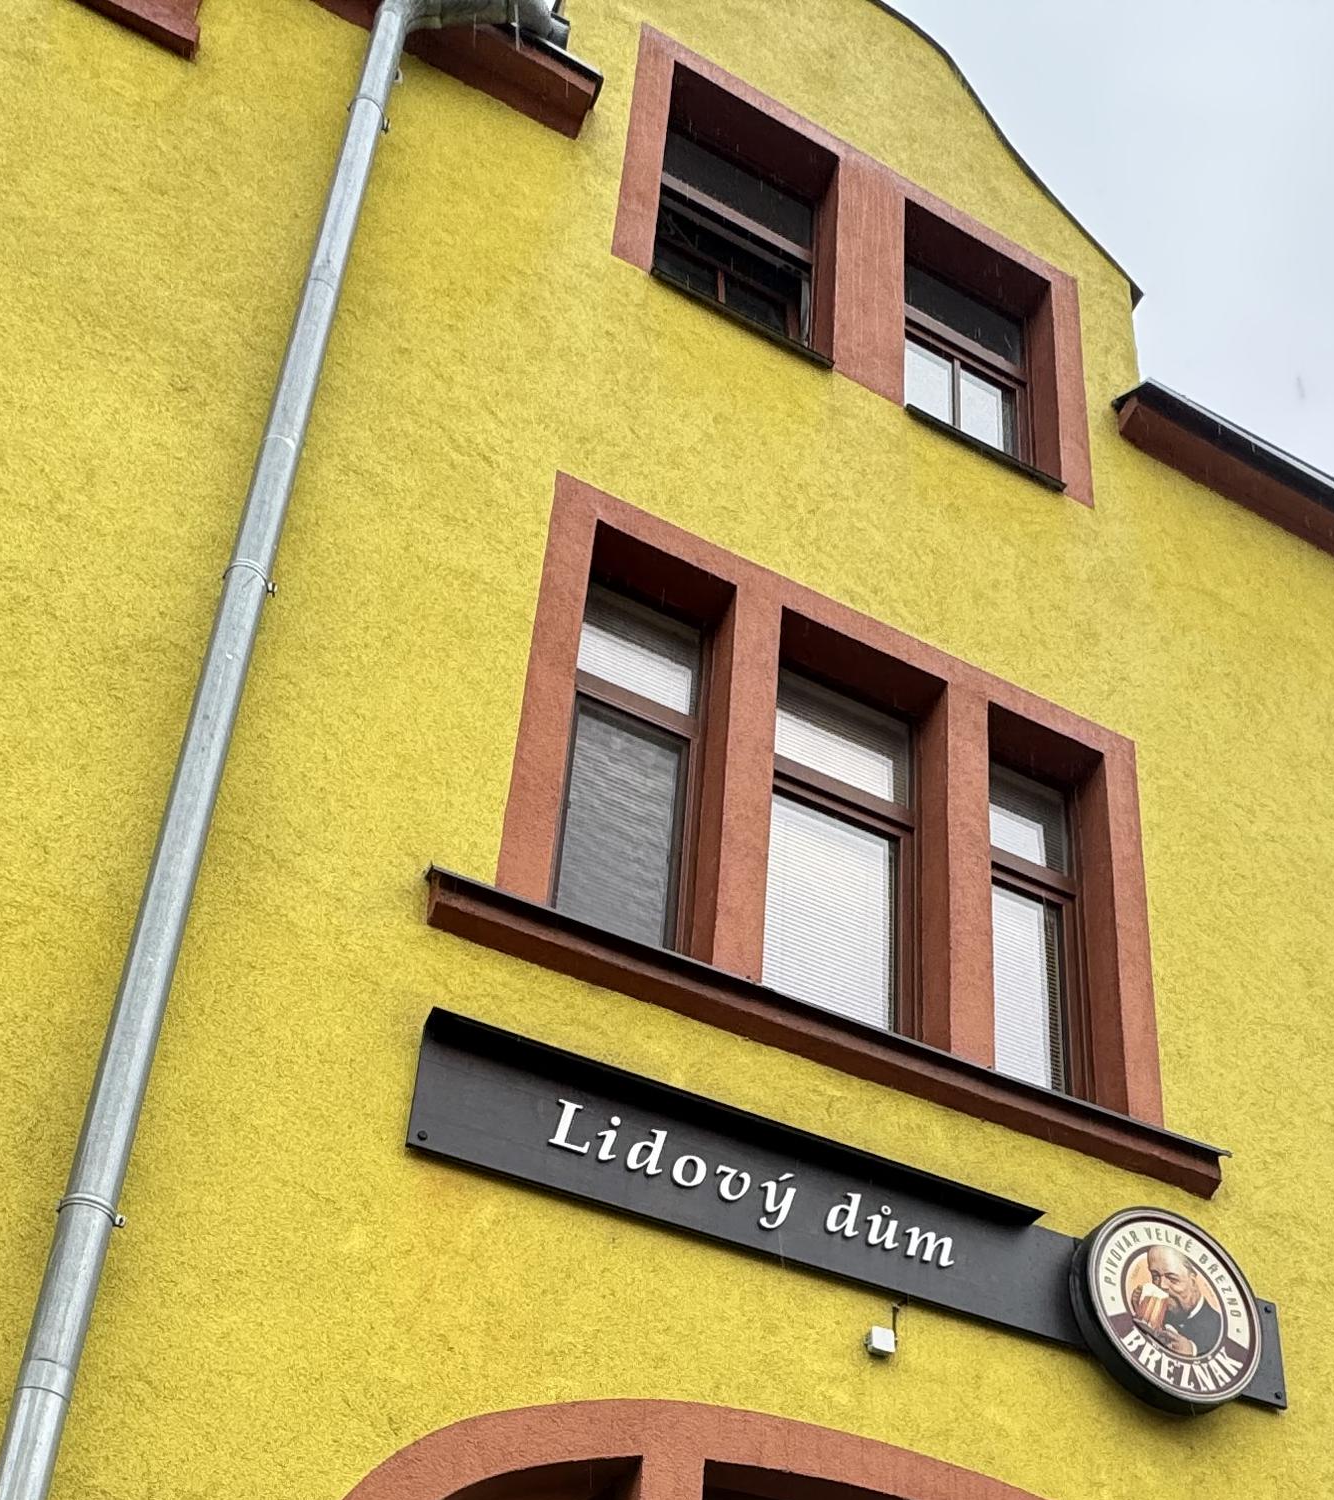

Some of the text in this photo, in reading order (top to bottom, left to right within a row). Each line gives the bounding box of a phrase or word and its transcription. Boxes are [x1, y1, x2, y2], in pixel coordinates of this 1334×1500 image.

[547, 1098, 956, 1268] Lidový dům
[1103, 1229, 1141, 1287] PIVOVAR
[1143, 1226, 1193, 1253] VELKÉ
[1120, 1326, 1244, 1392] BŘEZŇÁK
